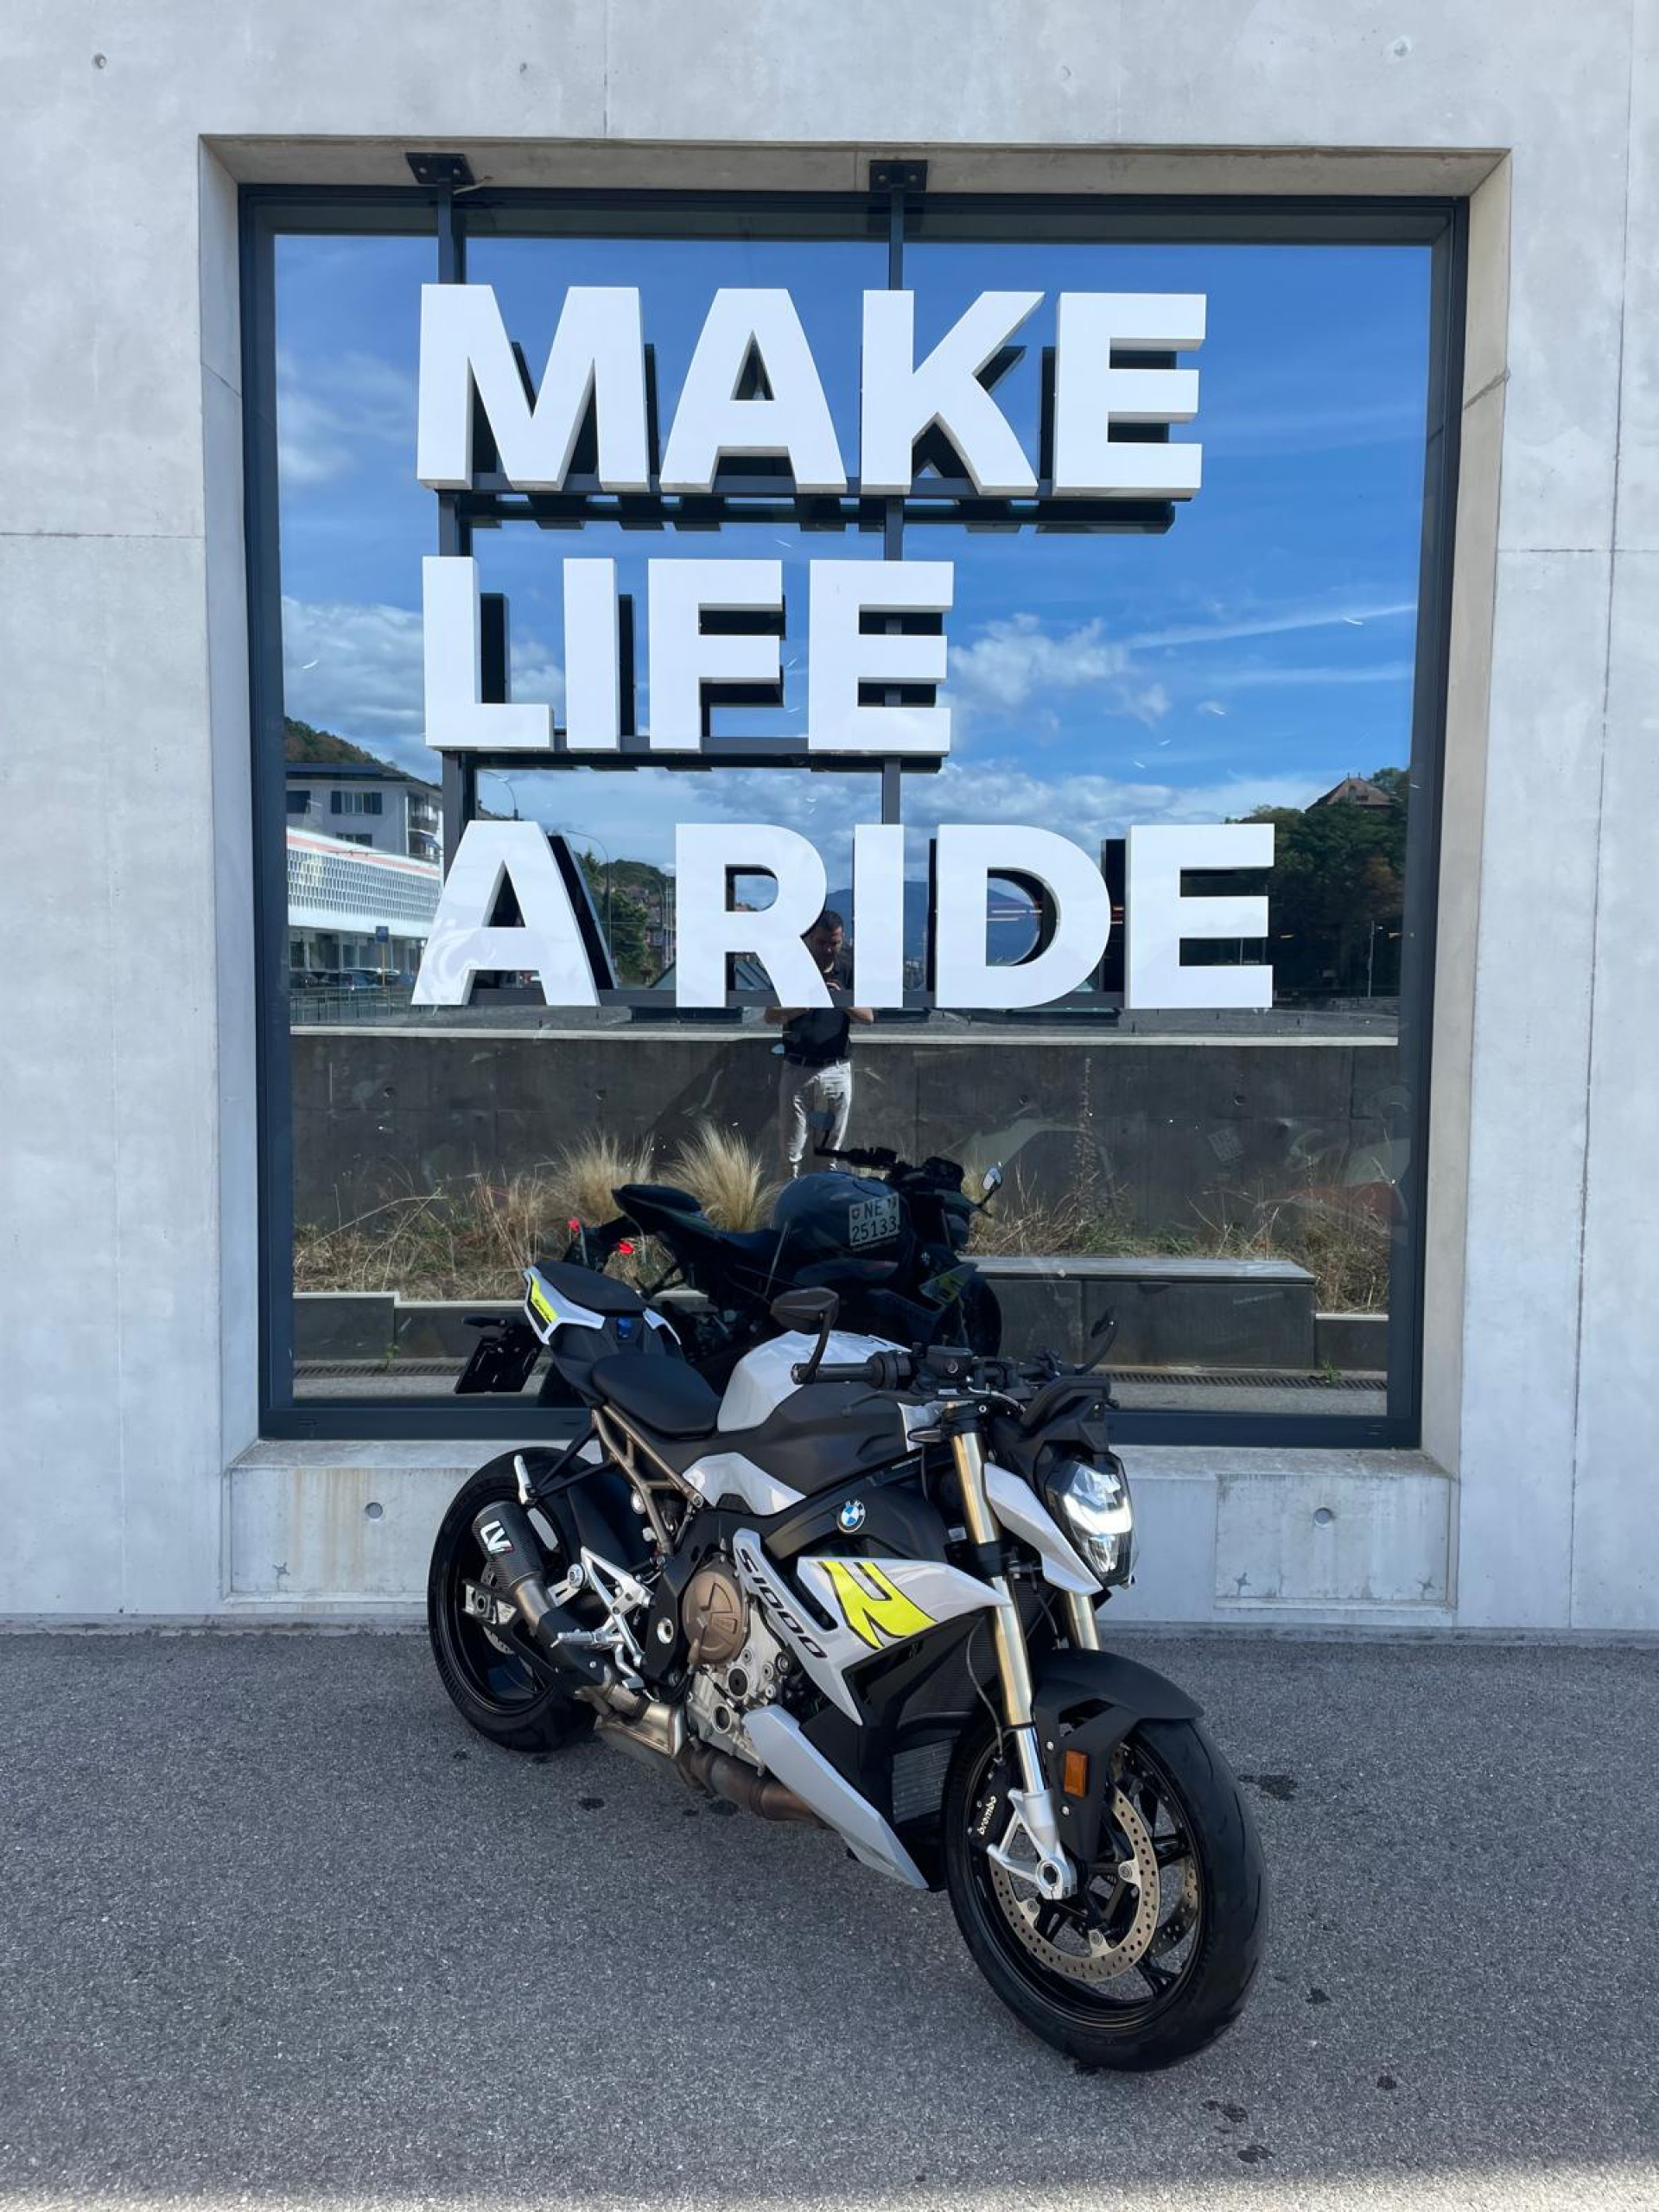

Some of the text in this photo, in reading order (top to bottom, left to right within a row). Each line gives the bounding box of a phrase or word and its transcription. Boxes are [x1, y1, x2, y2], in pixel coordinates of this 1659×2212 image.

[417, 283, 1207, 495] MAKE
[423, 556, 954, 754] LIFE
[411, 820, 1274, 1009] A RIDE
[852, 1216, 897, 1243] 25133
[863, 1201, 883, 1219] NE
[735, 1548, 828, 1658] S1000
[976, 1796, 996, 1835] brembo
